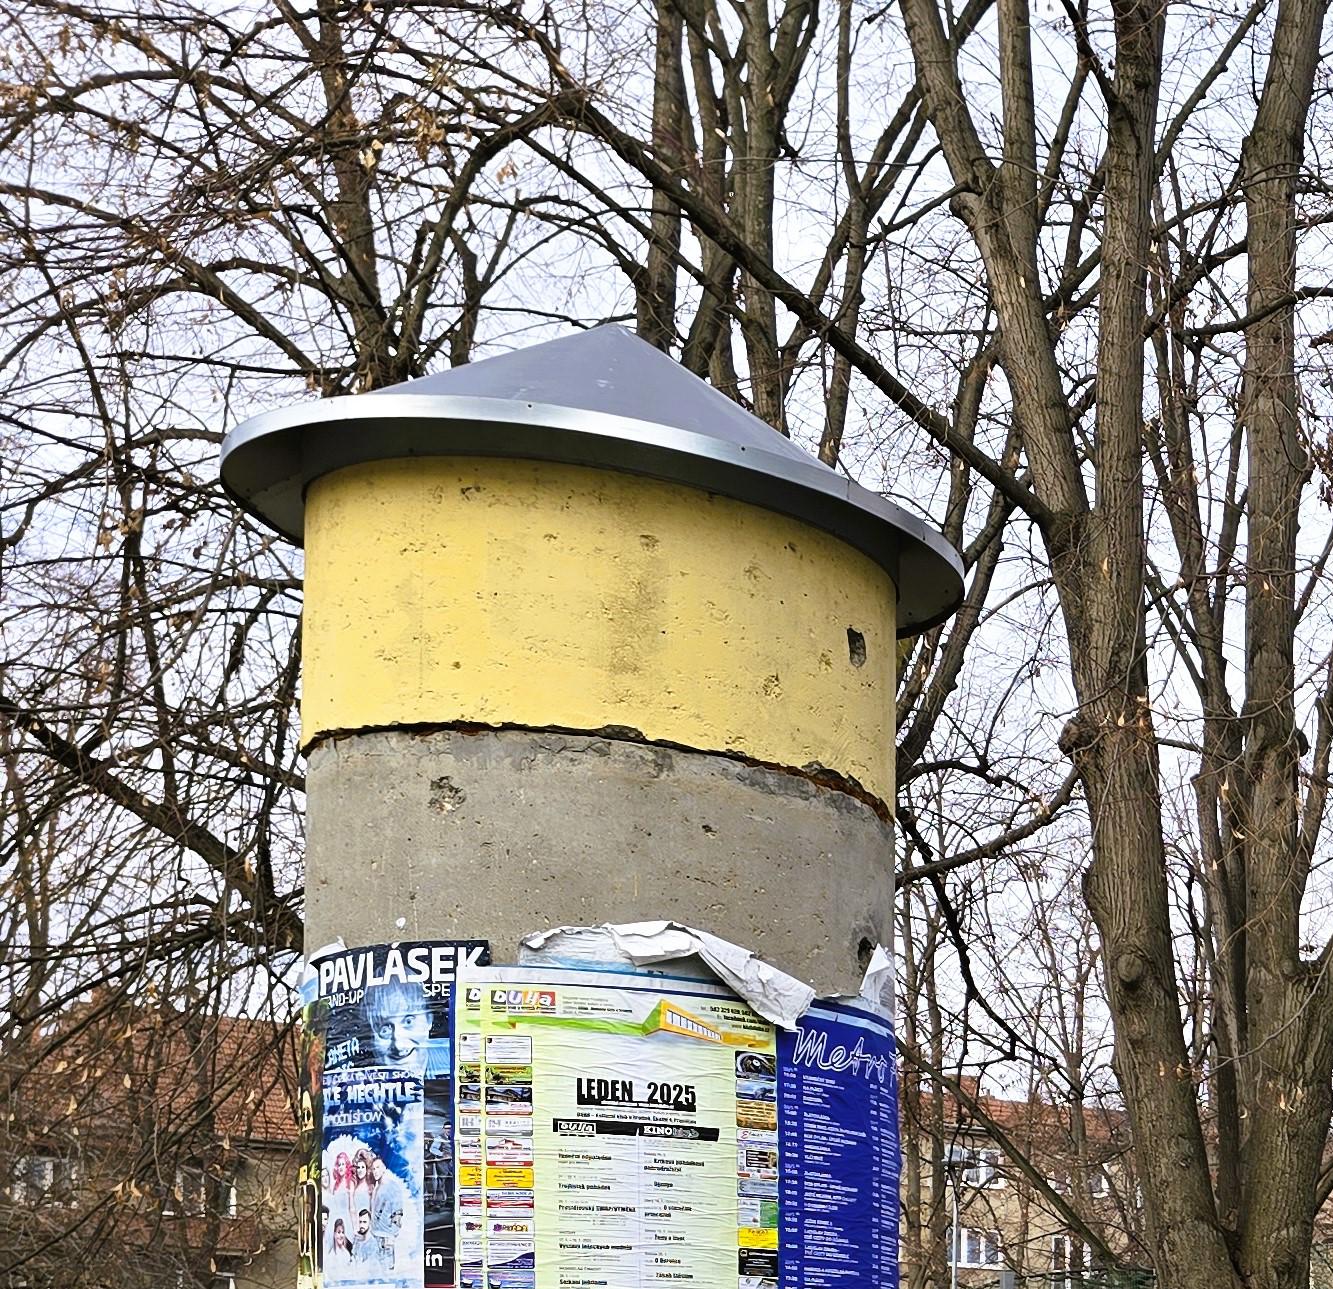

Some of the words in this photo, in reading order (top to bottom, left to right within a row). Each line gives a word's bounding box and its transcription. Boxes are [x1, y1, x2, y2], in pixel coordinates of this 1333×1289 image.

[577, 1077, 633, 1104] LEDEN
[647, 1081, 696, 1107] 2025
[643, 1125, 672, 1136] KINO
